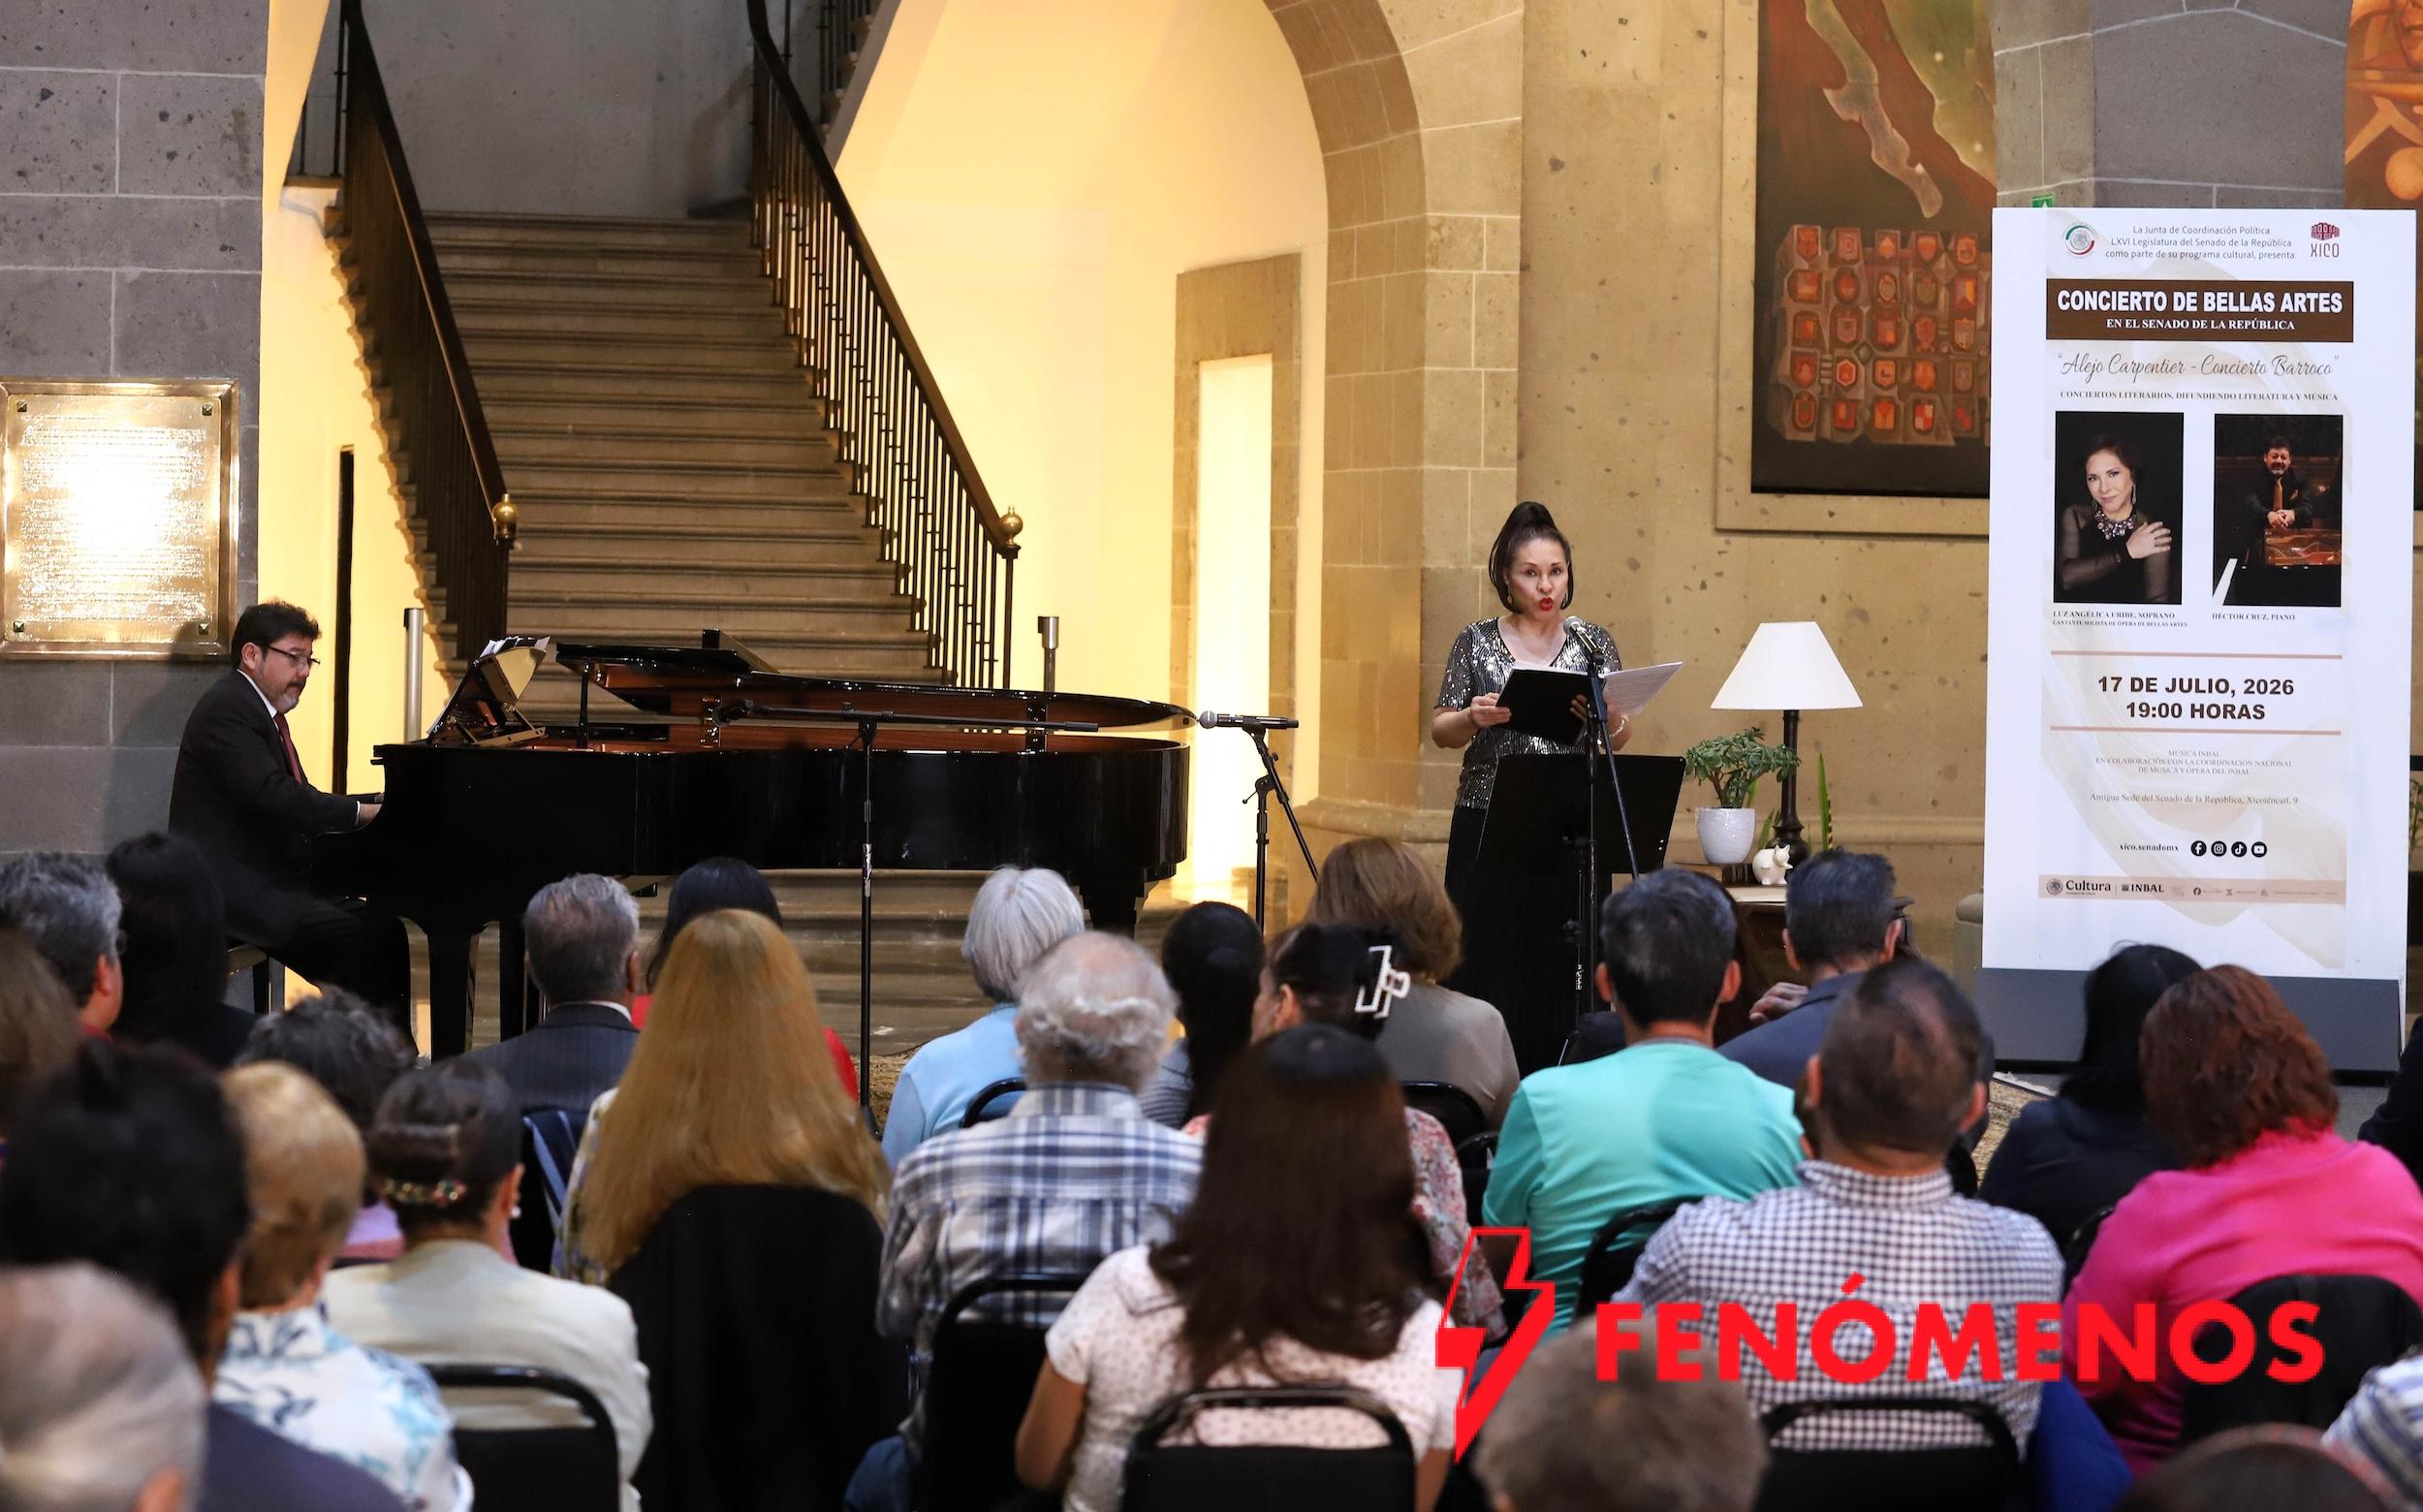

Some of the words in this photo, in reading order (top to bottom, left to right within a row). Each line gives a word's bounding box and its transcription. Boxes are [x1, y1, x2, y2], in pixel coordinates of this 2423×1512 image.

[2182, 226, 2237, 235] Coordinación
[2240, 226, 2270, 235] Política
[2111, 237, 2130, 246] LXVI
[2132, 237, 2178, 248] Legislatura
[2180, 237, 2192, 246] del
[2195, 238, 2226, 247] Senado
[2228, 238, 2239, 247] de
[2241, 238, 2249, 247] la
[2250, 238, 2292, 249] República
[2131, 251, 2153, 260] parte
[2180, 252, 2220, 261] programa
[2222, 251, 2256, 260] cultural,
[2310, 243, 2340, 258] XICO
[2057, 290, 2167, 312] CONCIERTO
[2173, 291, 2199, 312] DE
[2203, 291, 2276, 313] BELLAS
[2280, 292, 2343, 313] ARTES
[2106, 318, 2124, 329] EN
[2124, 318, 2141, 329] EL
[2142, 319, 2190, 330] SENADO
[2192, 319, 2209, 330] DE
[2211, 320, 2227, 330] LA
[2228, 317, 2295, 331] REPÚBLICA
[2108, 354, 2185, 384] Carpentier
[2200, 355, 2267, 376] Concierto
[2118, 392, 2174, 400] LITERARIOS,
[2097, 677, 2123, 693] 17
[2130, 677, 2158, 693] DE
[2165, 677, 2236, 697] JULIO,
[2243, 678, 2295, 695] 2026
[2126, 702, 2183, 718] 19:00
[2190, 703, 2266, 720] HORAS
[2090, 794, 2120, 803] Antigua
[2141, 794, 2153, 803] del
[2195, 795, 2203, 803] la
[2065, 880, 2111, 892] Cultura
[2131, 884, 2164, 893] INBAL
